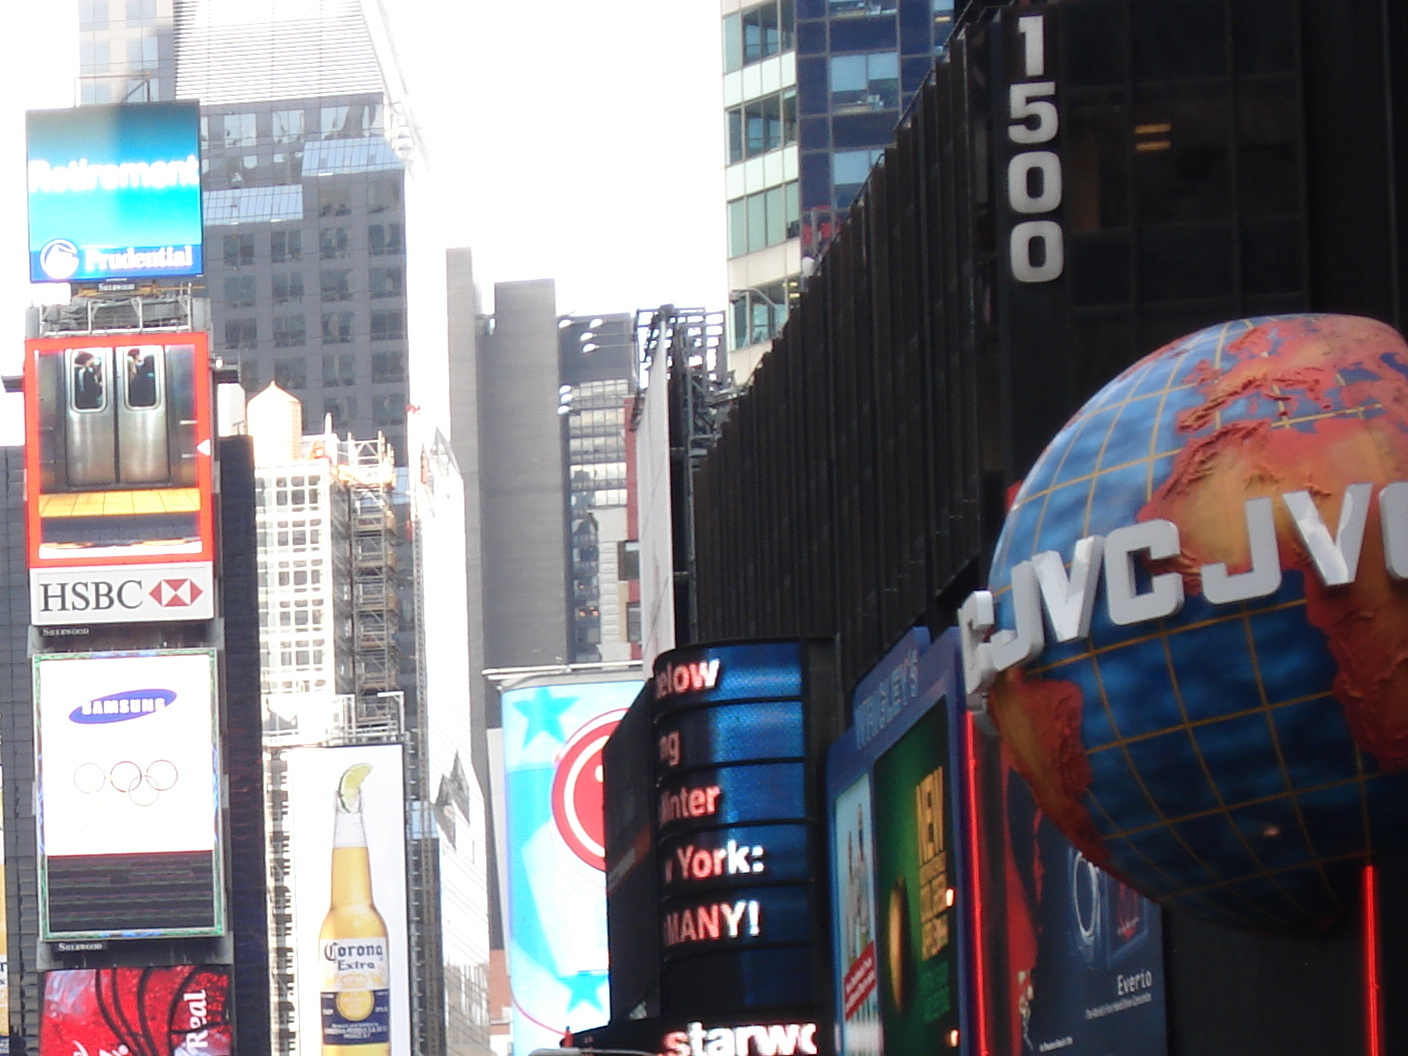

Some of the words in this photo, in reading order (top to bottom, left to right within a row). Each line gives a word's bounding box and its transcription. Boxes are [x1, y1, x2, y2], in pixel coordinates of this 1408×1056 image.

[1008, 15, 1065, 283] 1500
[28, 155, 200, 193] Retirement
[85, 246, 194, 271] Prudential
[39, 579, 144, 612] HSBC
[993, 519, 1185, 672] JVC
[81, 697, 166, 716] SAMSUNG
[677, 839, 765, 880] York:
[324, 942, 384, 962] Corona
[338, 960, 376, 971] Extra
[1118, 969, 1154, 997] Everio
[183, 989, 209, 1051] Real
